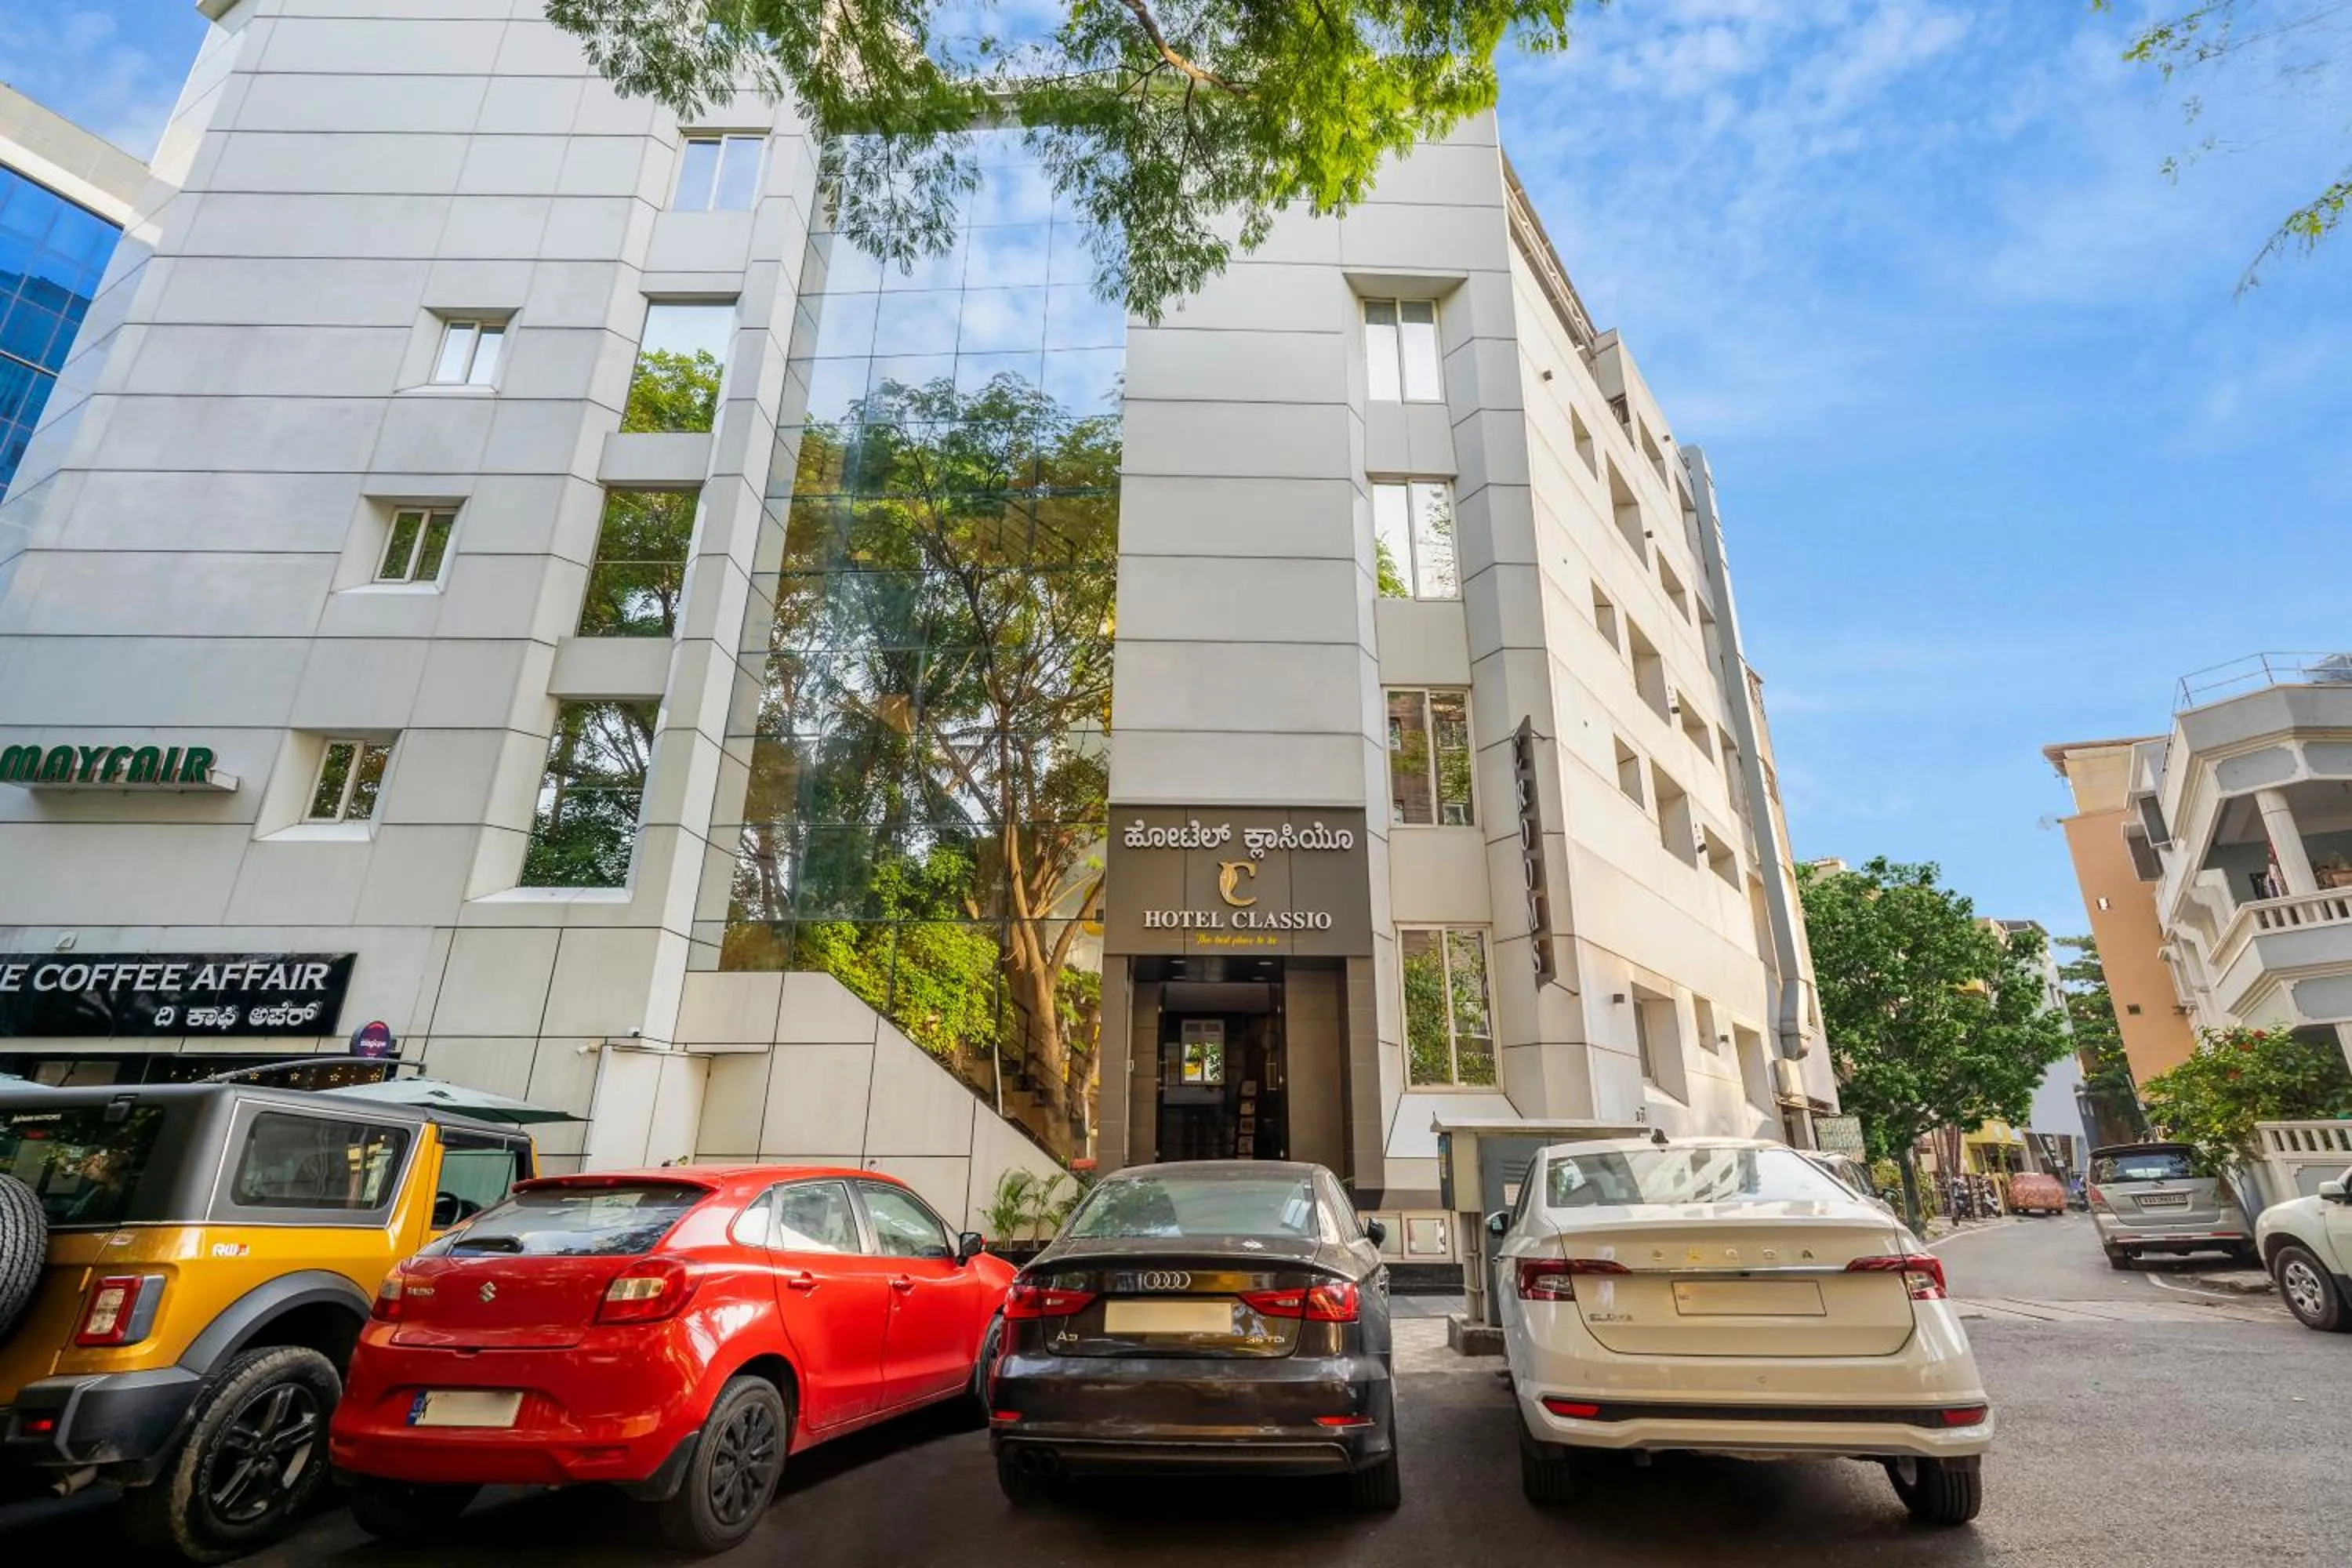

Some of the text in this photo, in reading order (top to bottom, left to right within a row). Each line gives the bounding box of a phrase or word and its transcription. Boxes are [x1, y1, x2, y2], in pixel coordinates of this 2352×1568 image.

[1, 744, 214, 782] MAYFAIR
[1144, 910, 1332, 929] HOTEL CLASSIO
[33, 964, 189, 992] COFFEE
[189, 964, 328, 991] AFFAIR
[154, 1005, 175, 1026] ದಿ
